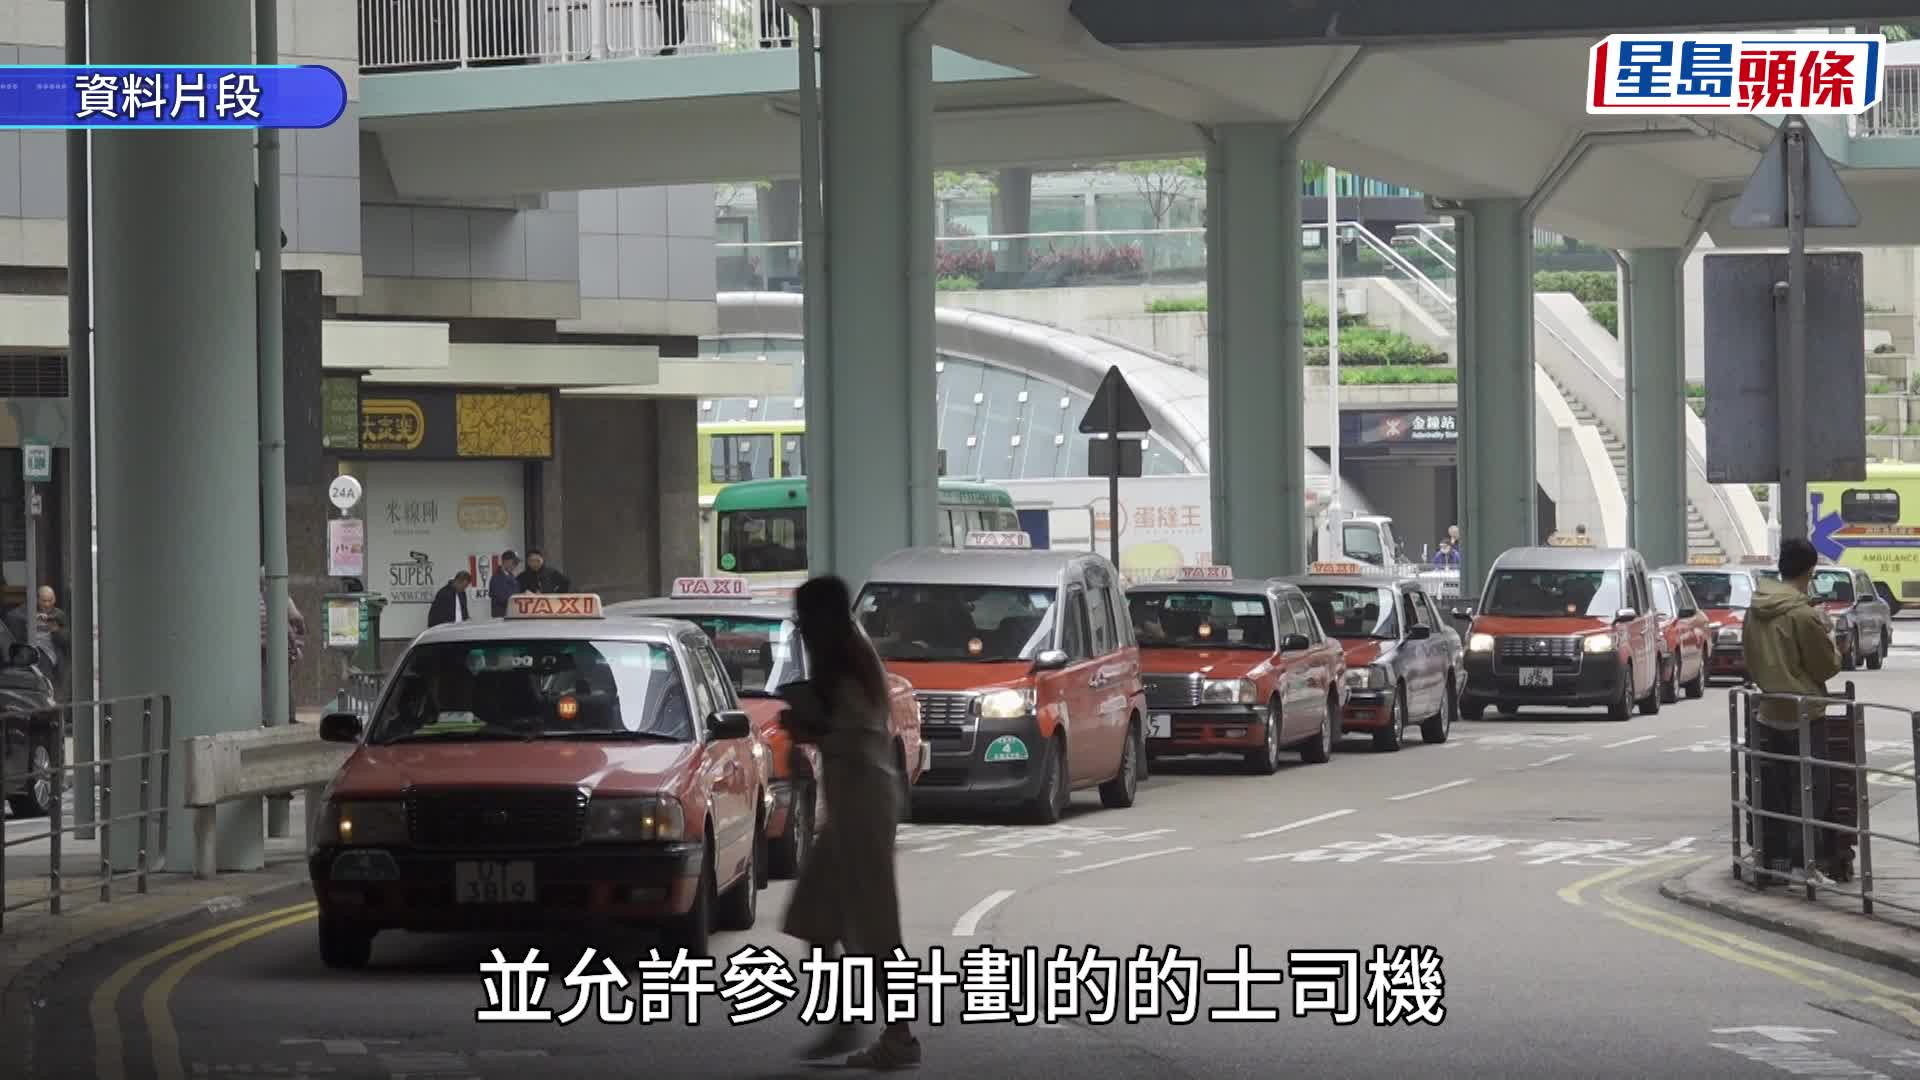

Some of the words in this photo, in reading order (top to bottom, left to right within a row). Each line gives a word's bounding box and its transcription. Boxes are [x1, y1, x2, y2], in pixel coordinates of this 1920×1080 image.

[332, 486, 356, 499] 24A
[970, 532, 1025, 546] TAXI
[1862, 553, 1919, 562] AMBULANCE
[389, 566, 434, 587] SUPER
[1181, 566, 1228, 578] TAXI
[677, 578, 743, 594] TAXI
[513, 596, 594, 615] TAXI
